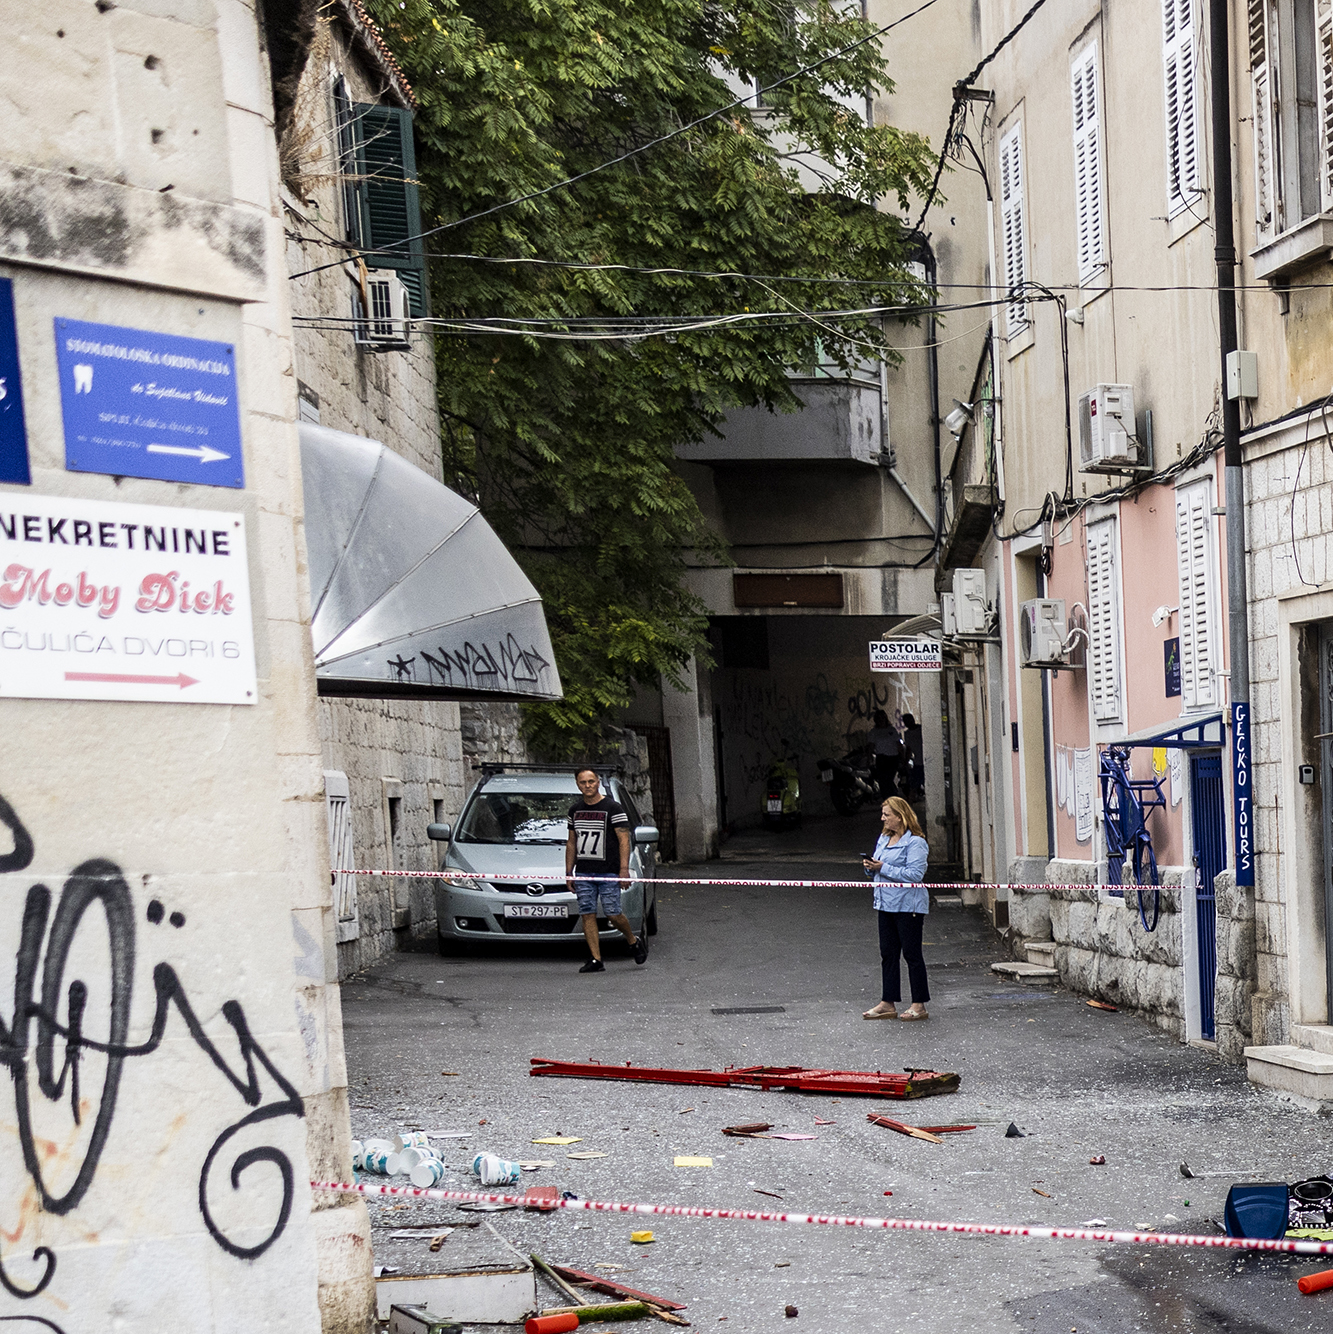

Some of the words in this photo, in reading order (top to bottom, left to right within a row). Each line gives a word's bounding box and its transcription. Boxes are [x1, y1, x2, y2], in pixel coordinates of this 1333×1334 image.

[0, 513, 231, 556] NEKRETNINE
[0, 563, 121, 619] Moby
[135, 570, 235, 615] Dick
[1, 626, 116, 654] ČULIĆA
[123, 636, 215, 658] DVORI
[222, 640, 241, 659] 6
[870, 643, 940, 654] POSTOLAR
[875, 653, 910, 661] KROJAČKE
[1235, 704, 1248, 786] GECKO
[580, 831, 601, 855] 77
[1238, 796, 1251, 870] TOURS
[511, 906, 523, 916] ST
